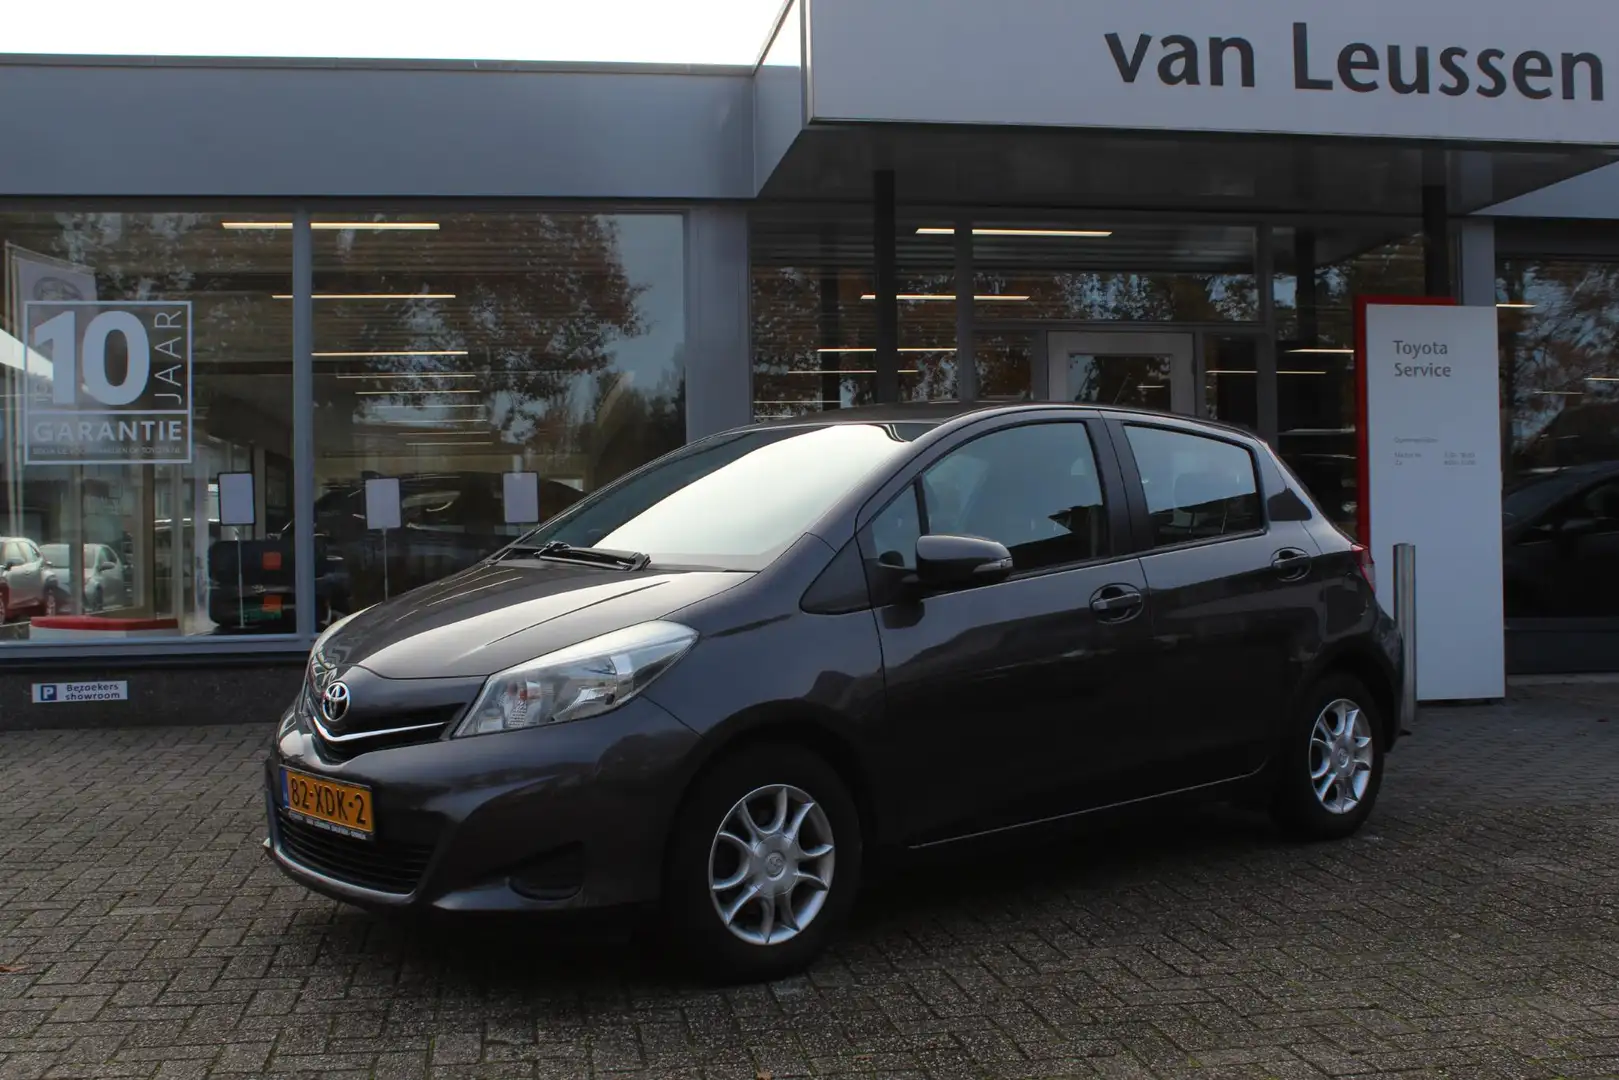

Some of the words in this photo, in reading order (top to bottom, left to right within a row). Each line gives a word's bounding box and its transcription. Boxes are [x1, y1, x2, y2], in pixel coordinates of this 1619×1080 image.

[1104, 32, 1255, 88] van
[1292, 22, 1604, 101] Leussen
[34, 310, 149, 406] 10
[154, 310, 182, 405] JAAR
[1392, 340, 1448, 359] Toyota
[1394, 362, 1451, 377] Service
[33, 420, 182, 442] GARANTIE
[65, 692, 119, 700] showroom
[66, 684, 119, 692] Bezoekers
[291, 777, 366, 825] 82-XDK-2
